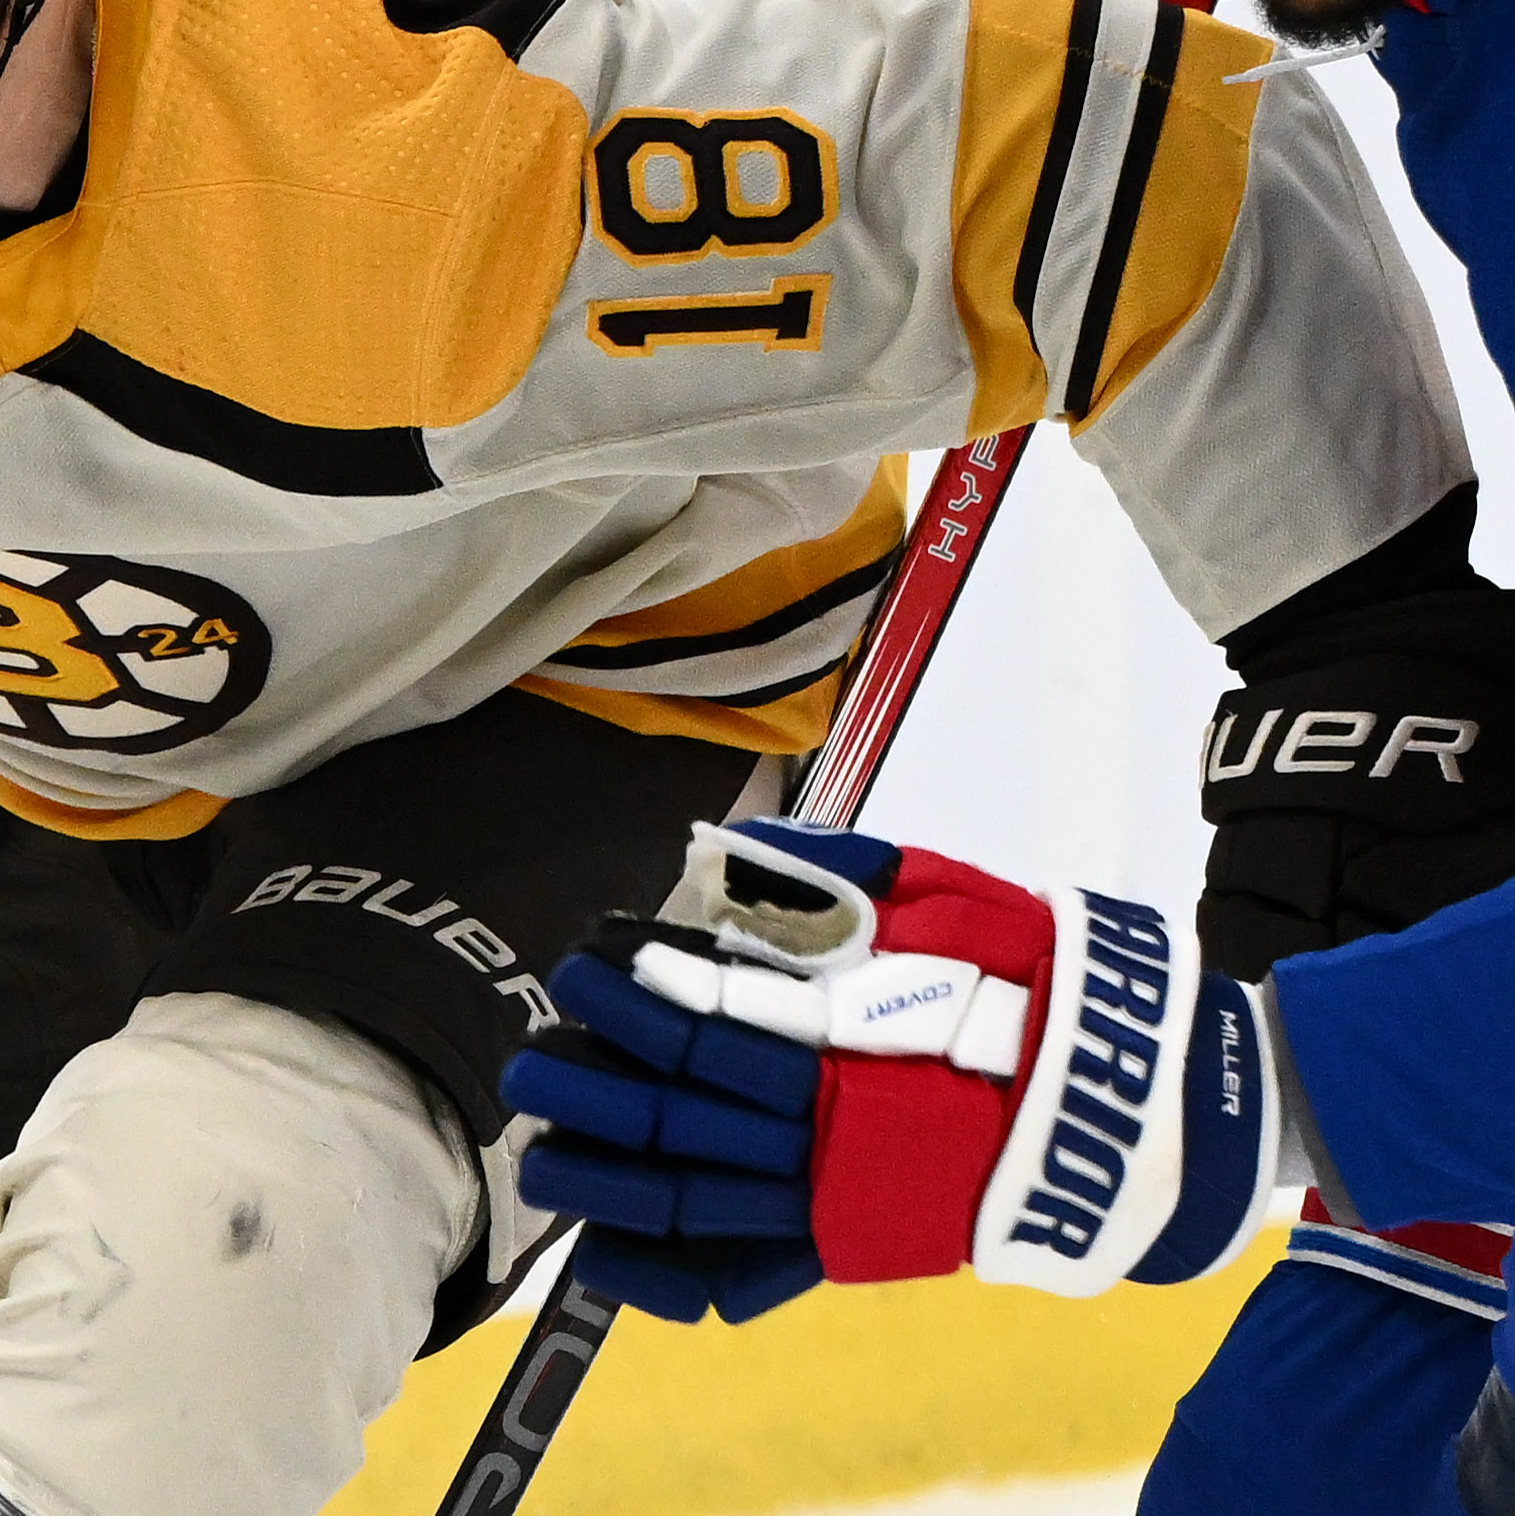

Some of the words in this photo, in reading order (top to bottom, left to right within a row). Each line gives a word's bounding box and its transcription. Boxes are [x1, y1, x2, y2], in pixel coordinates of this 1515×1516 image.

[586, 107, 838, 357] 18
[136, 617, 239, 658] 24
[1198, 708, 1480, 789] UER
[231, 865, 561, 1034] BAUER
[863, 983, 953, 1022] COVERT
[1219, 1009, 1241, 1117] MILLER
